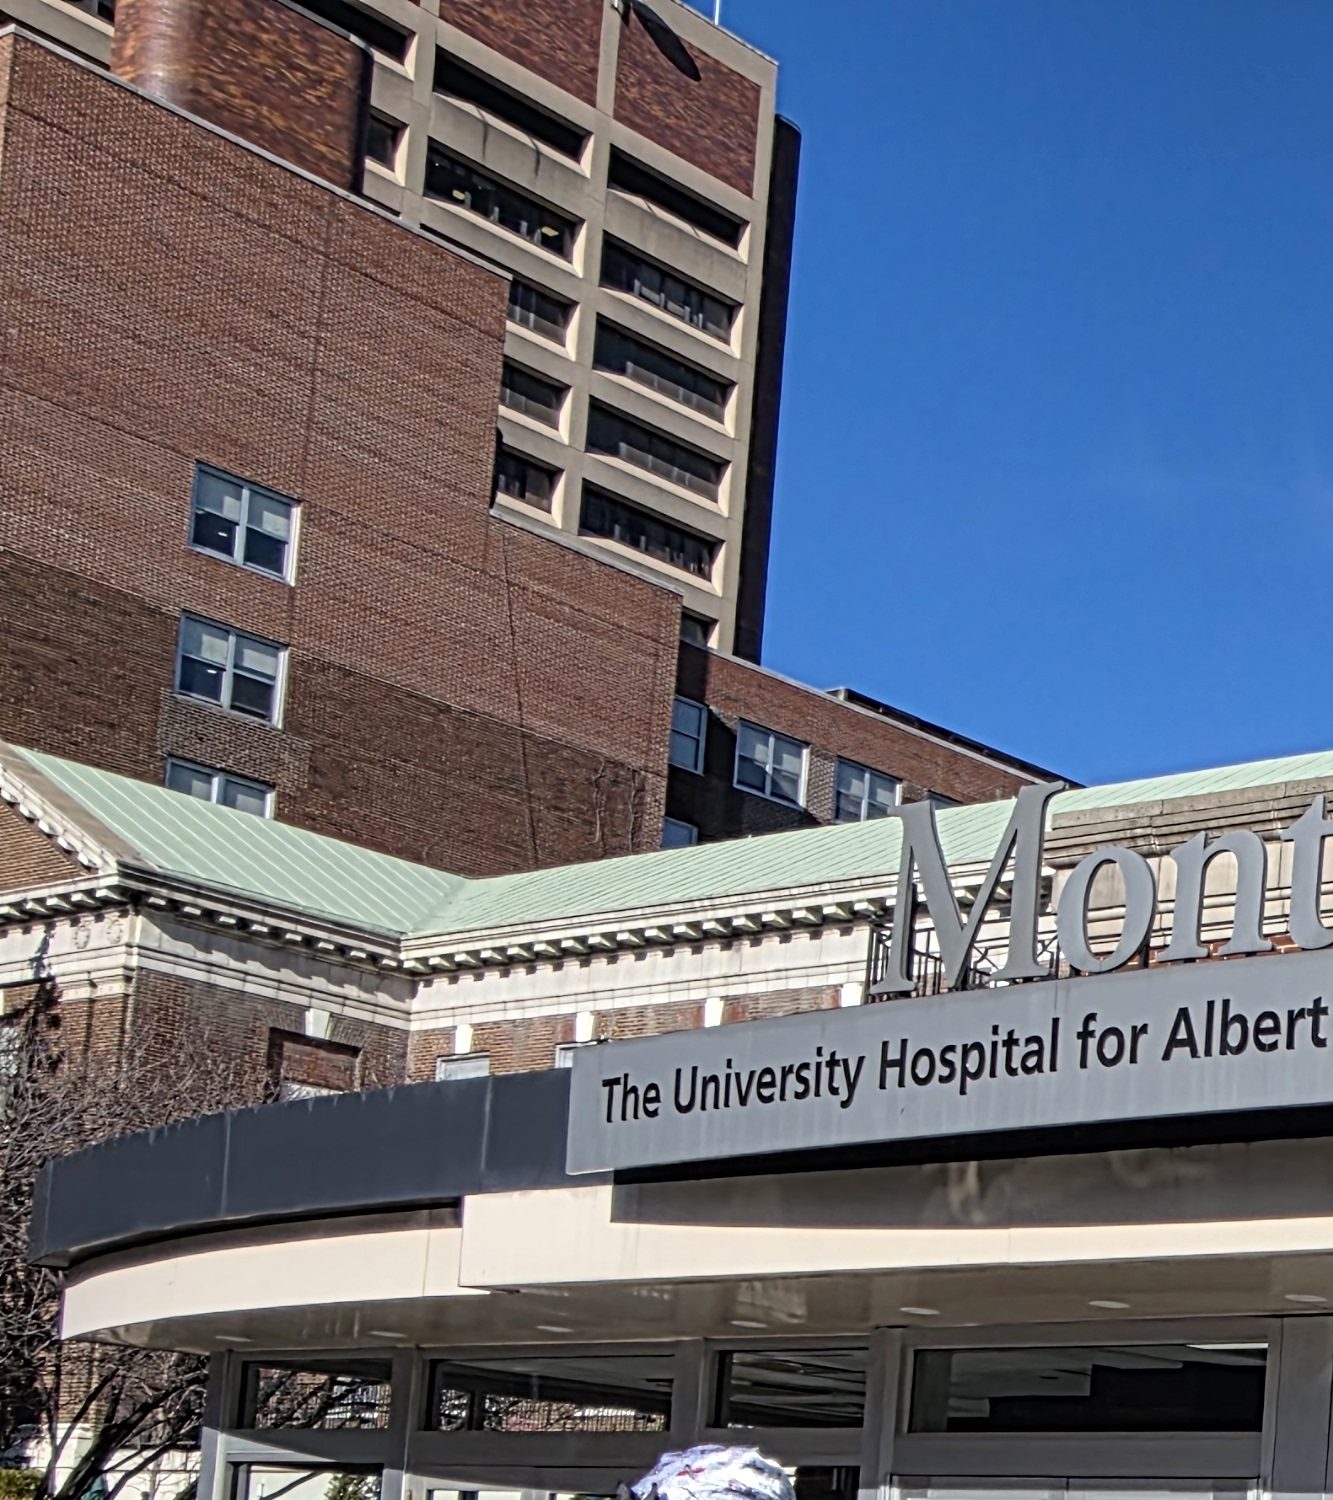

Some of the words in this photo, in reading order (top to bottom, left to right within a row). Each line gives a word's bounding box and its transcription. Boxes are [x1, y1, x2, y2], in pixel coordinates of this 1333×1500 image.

[602, 1077, 661, 1123] The
[673, 1047, 864, 1108] University
[879, 1017, 1059, 1095] Hospital
[1077, 1011, 1148, 1069] for
[1162, 995, 1328, 1062] Albert
